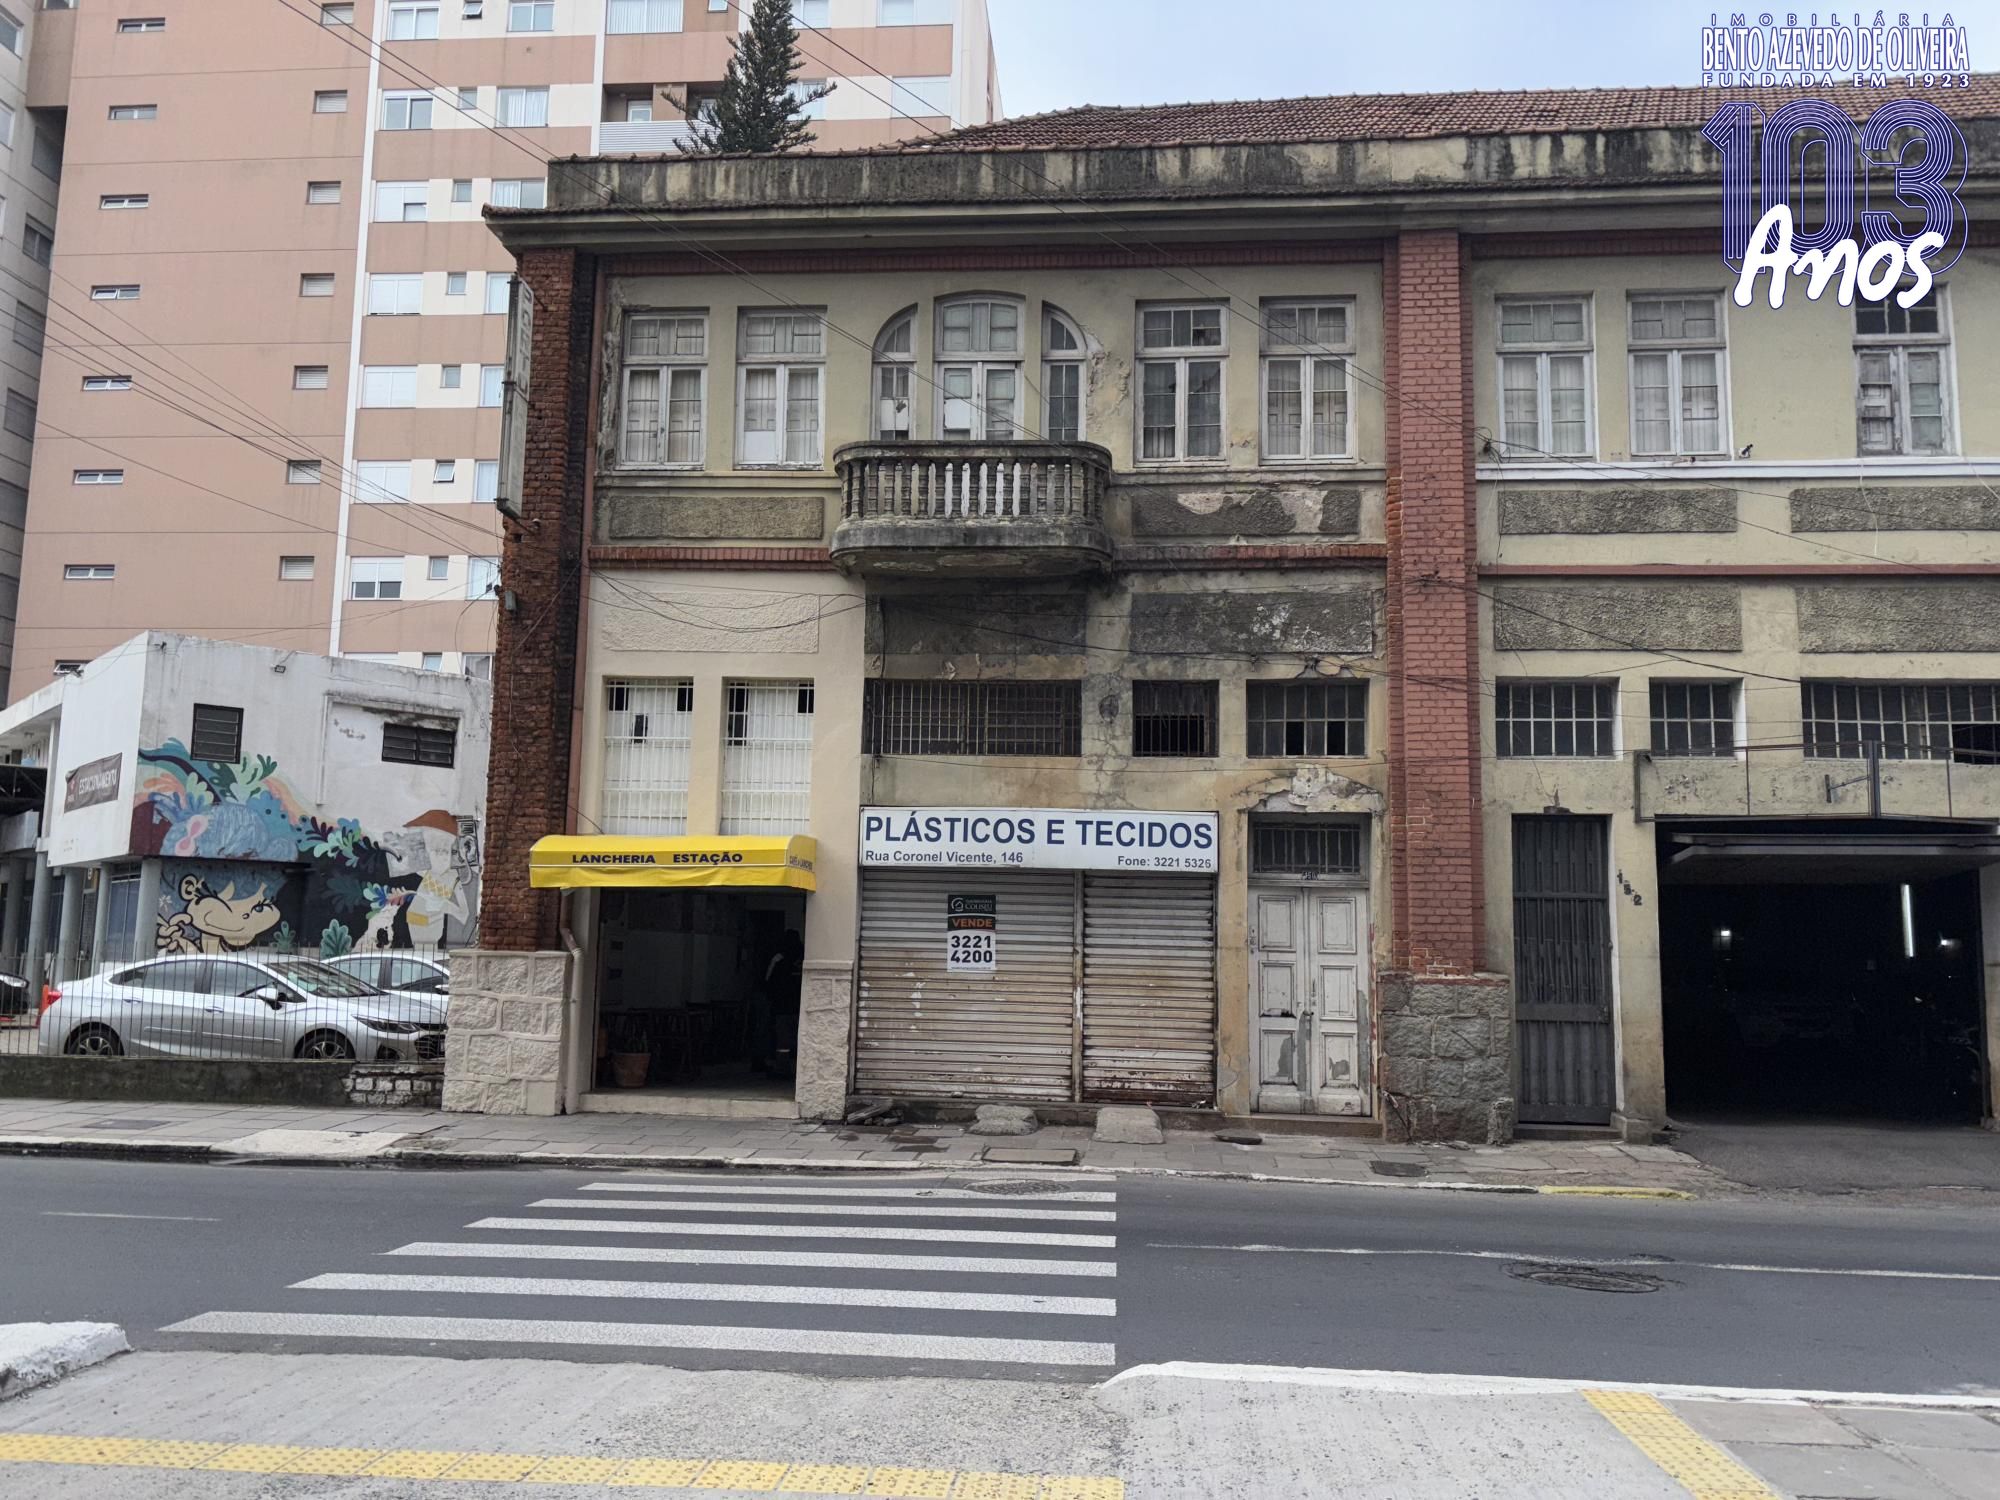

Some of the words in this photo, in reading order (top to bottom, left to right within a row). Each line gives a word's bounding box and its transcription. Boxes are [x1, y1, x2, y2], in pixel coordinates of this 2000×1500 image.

[864, 811, 1036, 845] PLÁSTICOS
[1047, 819, 1065, 845] E
[1075, 820, 1213, 849] TECIDOS
[572, 854, 656, 864] LANCHERIA
[673, 851, 743, 865] ESTAÇÃO
[865, 851, 890, 862] Rua
[893, 850, 942, 862] Coronel
[945, 851, 997, 864] Vicente,
[1001, 852, 1023, 863] 146
[1117, 855, 1150, 866] Fone:
[1154, 857, 1180, 867] 3221
[952, 918, 993, 928] VENDE
[951, 935, 991, 948] 3221
[950, 950, 993, 963] 4200
